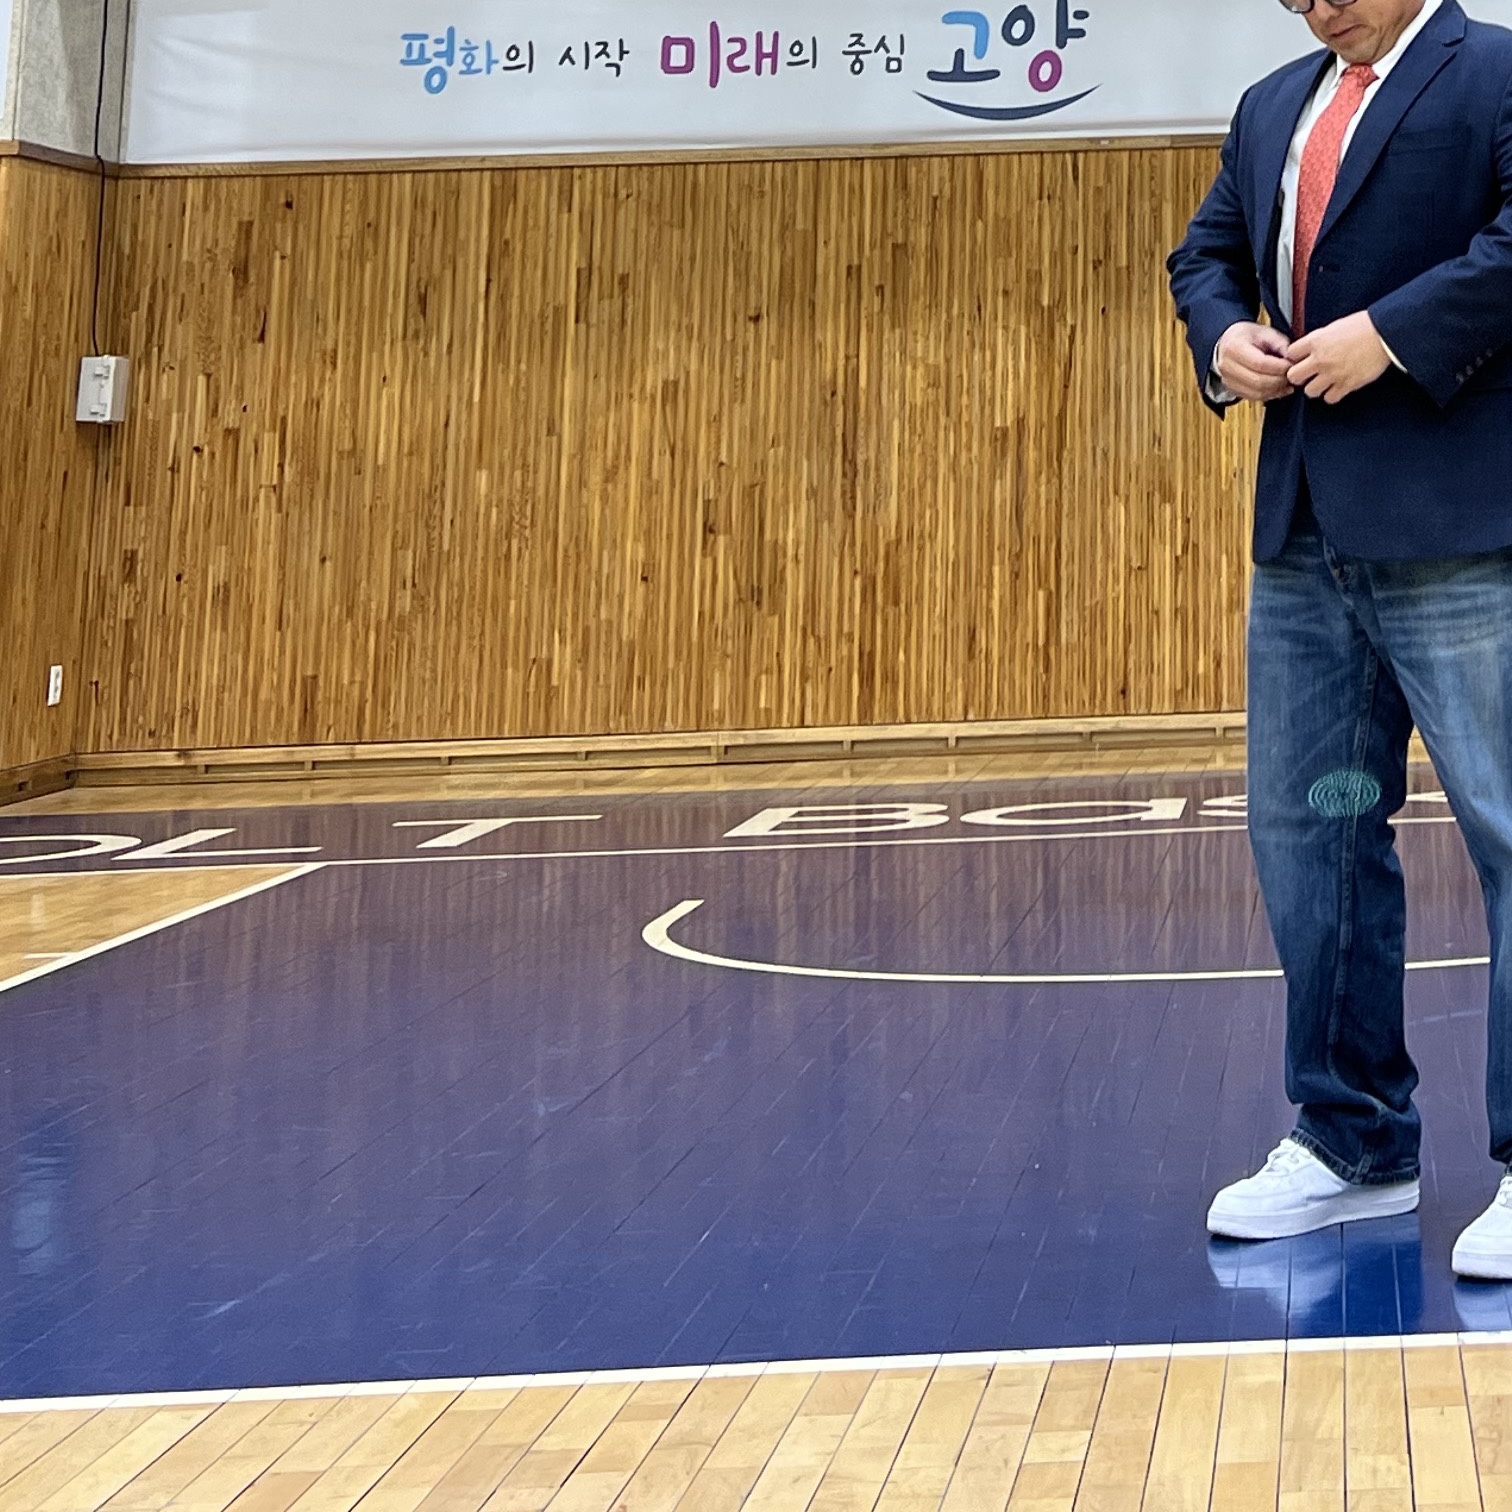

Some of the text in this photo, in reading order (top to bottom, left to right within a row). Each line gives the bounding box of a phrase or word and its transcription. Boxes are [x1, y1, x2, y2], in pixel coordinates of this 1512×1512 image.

[400, 26, 535, 94] 평화의
[558, 39, 630, 78] 시작
[660, 20, 819, 89] 미래의
[842, 33, 906, 74] 중심
